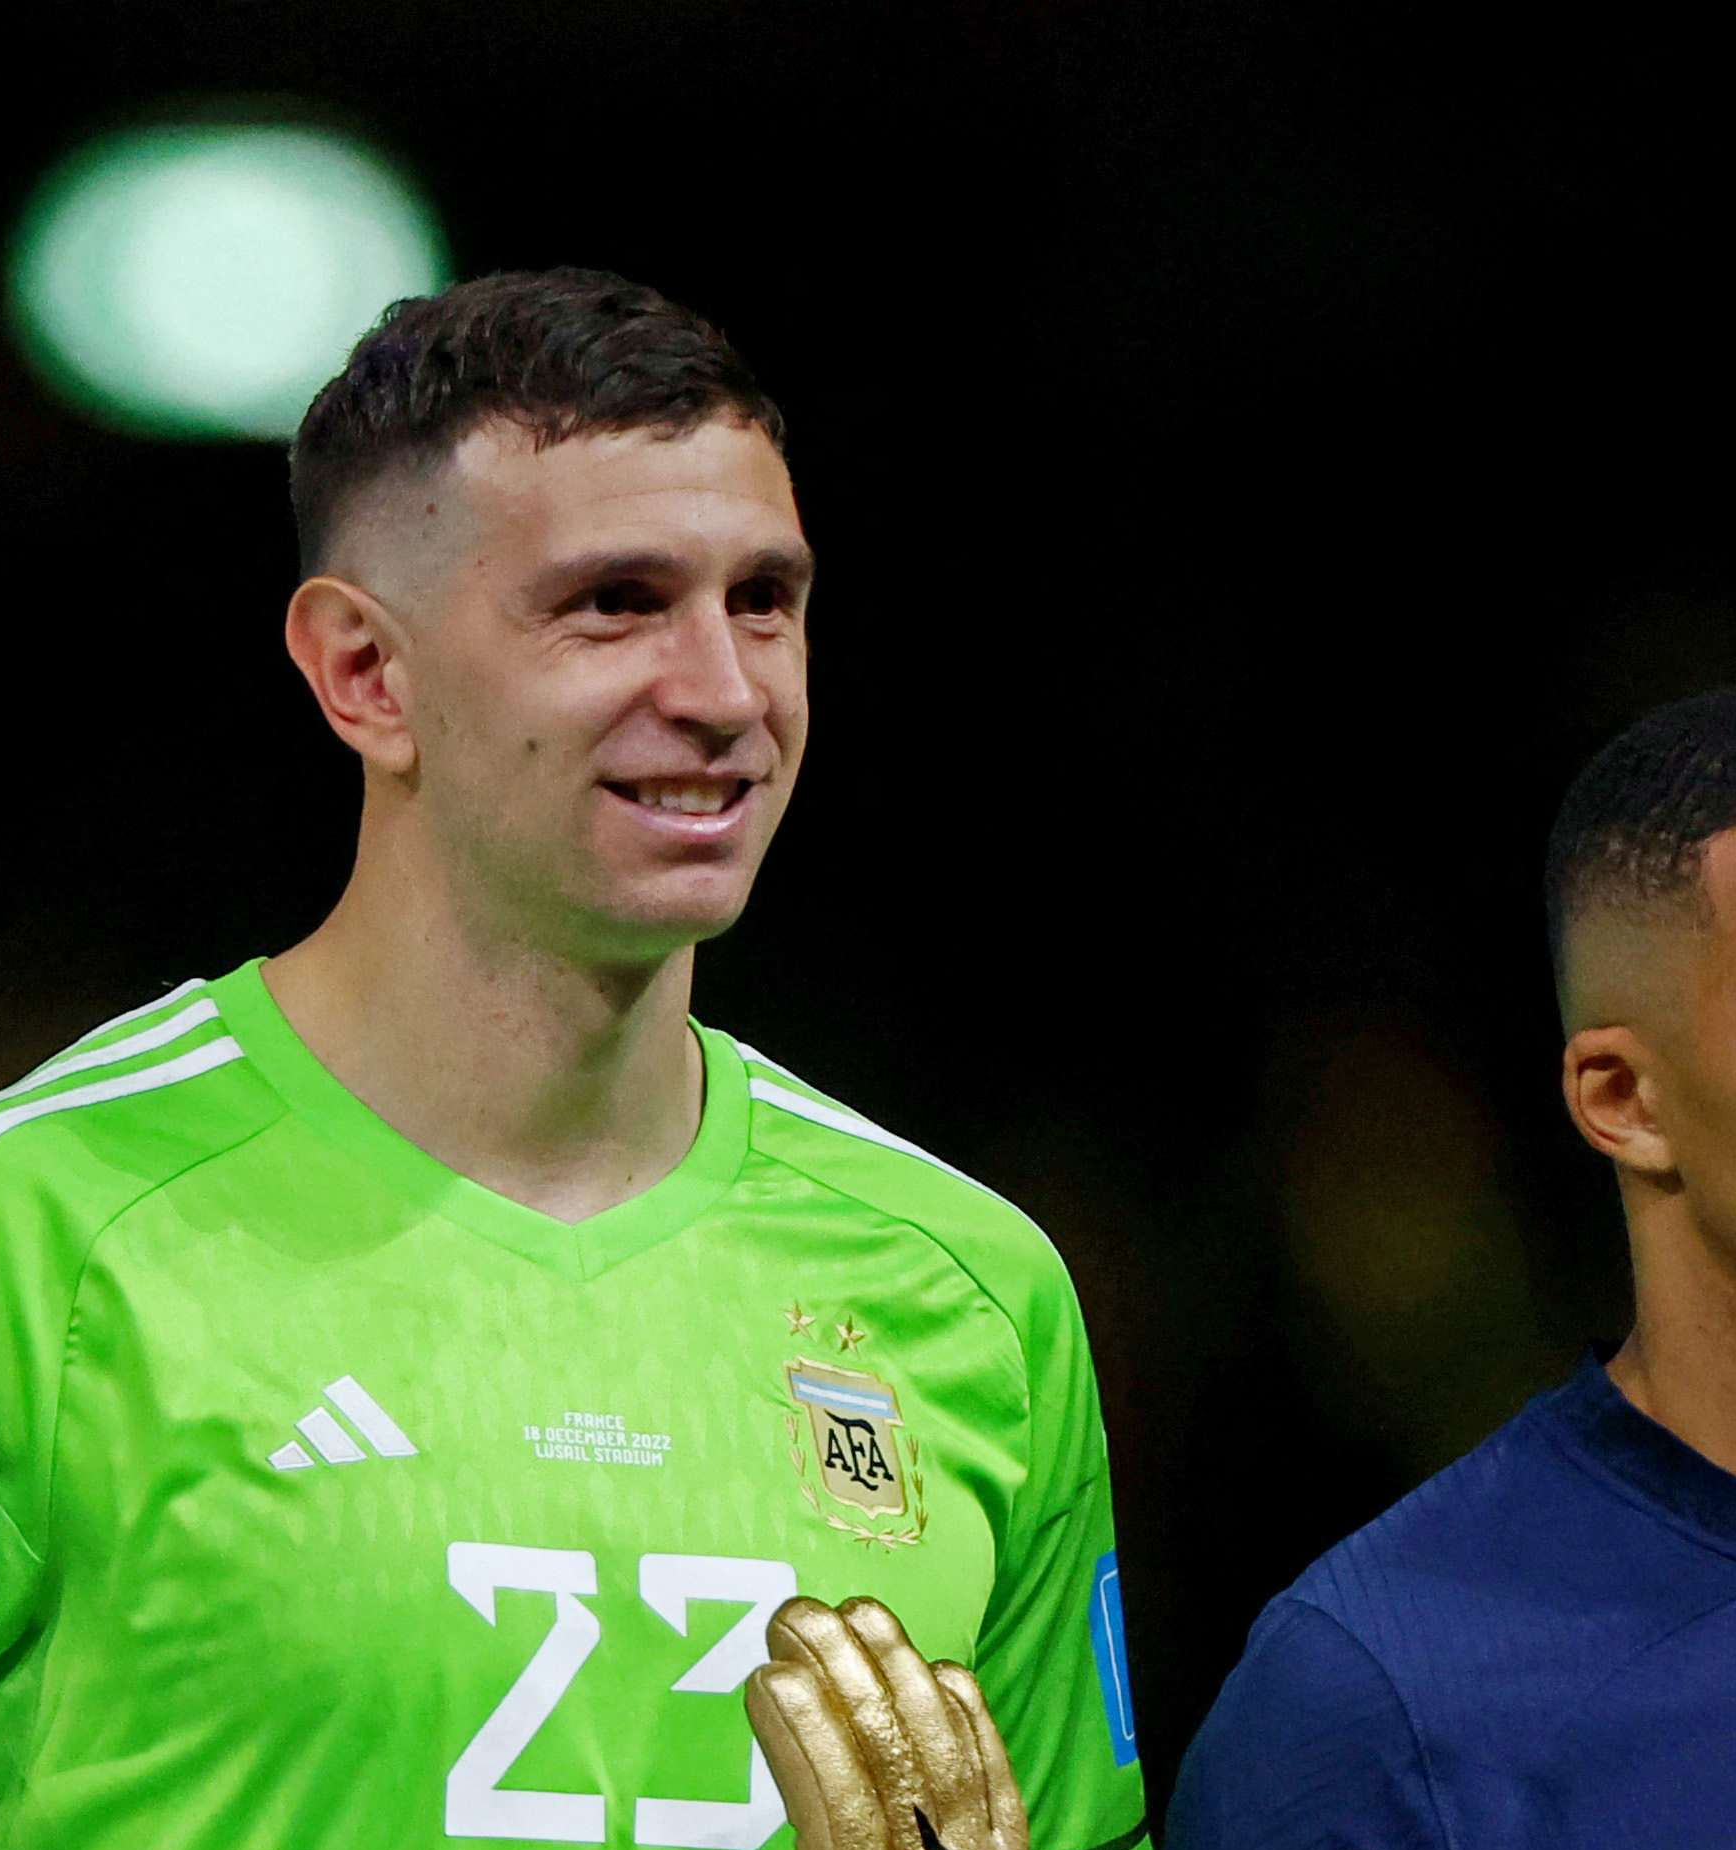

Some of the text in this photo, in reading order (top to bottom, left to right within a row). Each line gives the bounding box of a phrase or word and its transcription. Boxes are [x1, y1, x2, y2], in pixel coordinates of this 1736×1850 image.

[564, 1411, 625, 1430] FRANCE
[523, 1425, 672, 1450] 18 DECEMBER 2022
[535, 1442, 663, 1466] LUSAIL STADIUM
[824, 1408, 895, 1492] AFA
